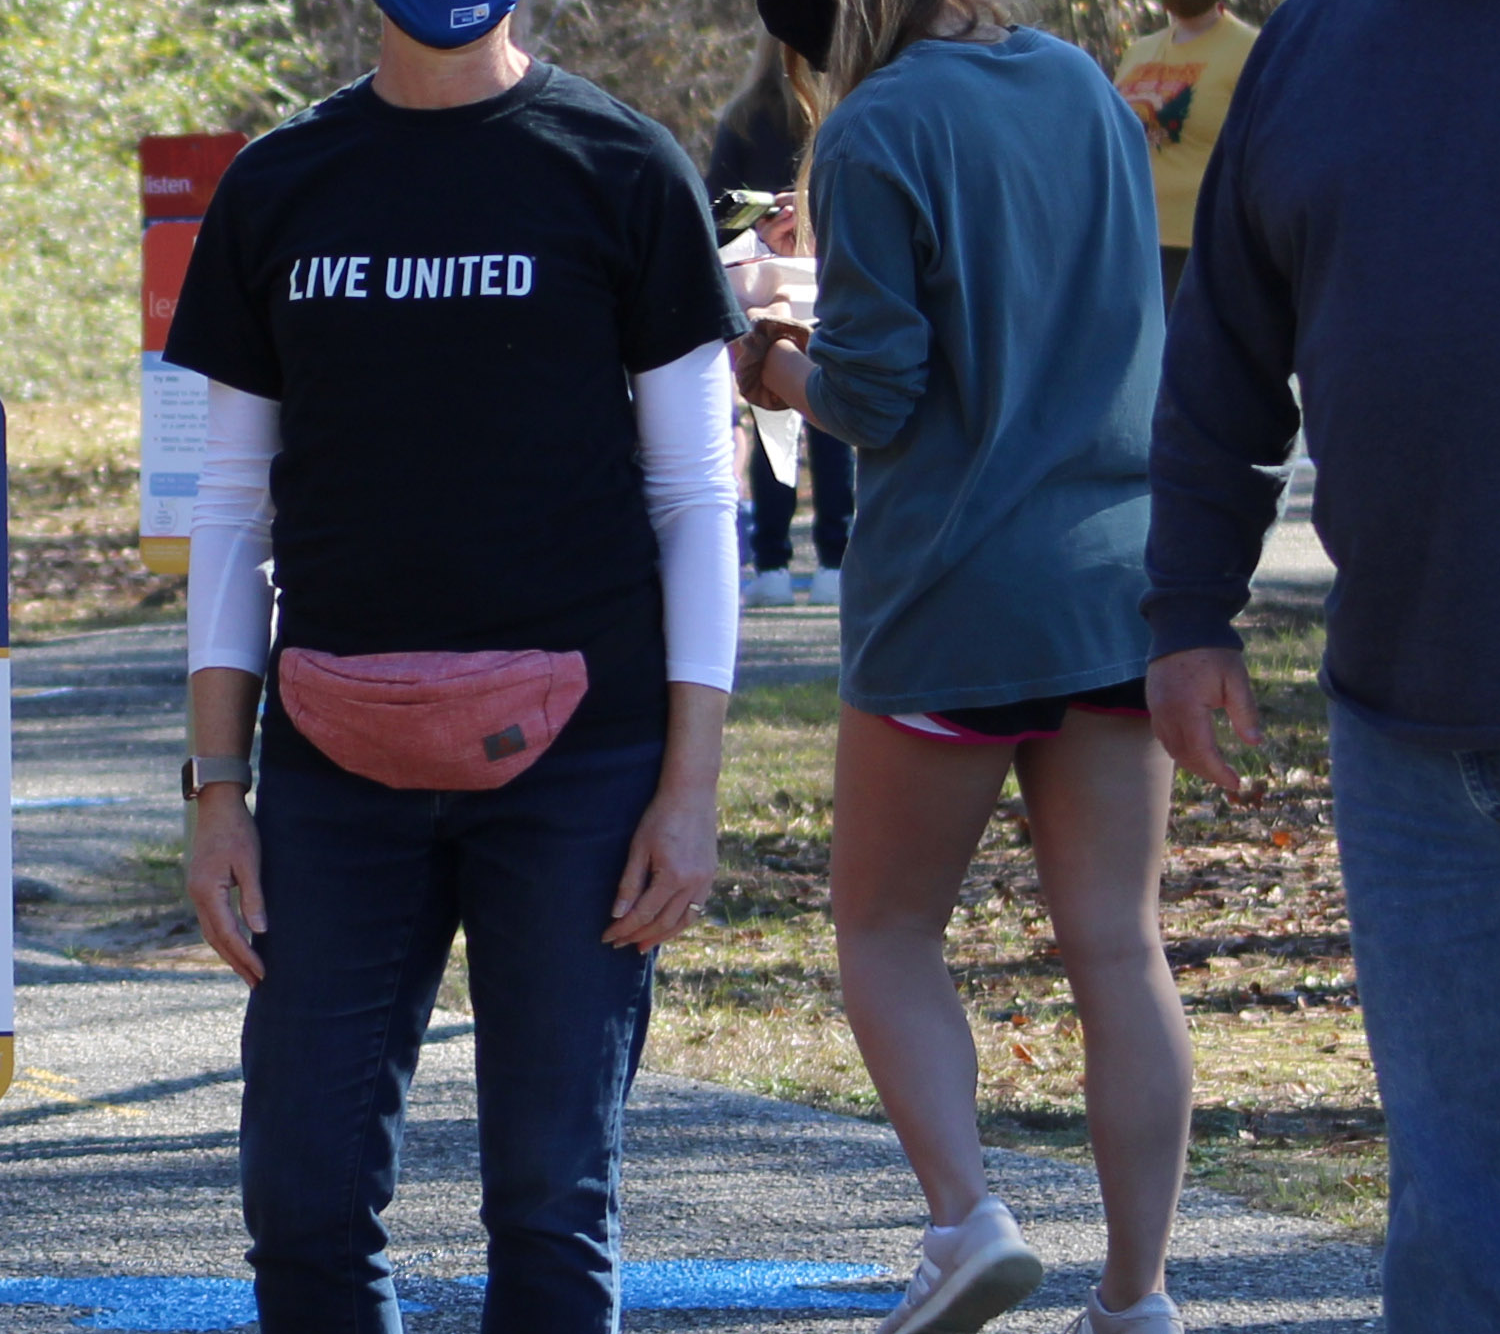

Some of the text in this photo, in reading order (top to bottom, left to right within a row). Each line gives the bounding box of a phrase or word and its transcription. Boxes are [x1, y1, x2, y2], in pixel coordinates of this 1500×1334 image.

[144, 176, 191, 194] listen
[289, 255, 532, 301] LIVE UNITED
